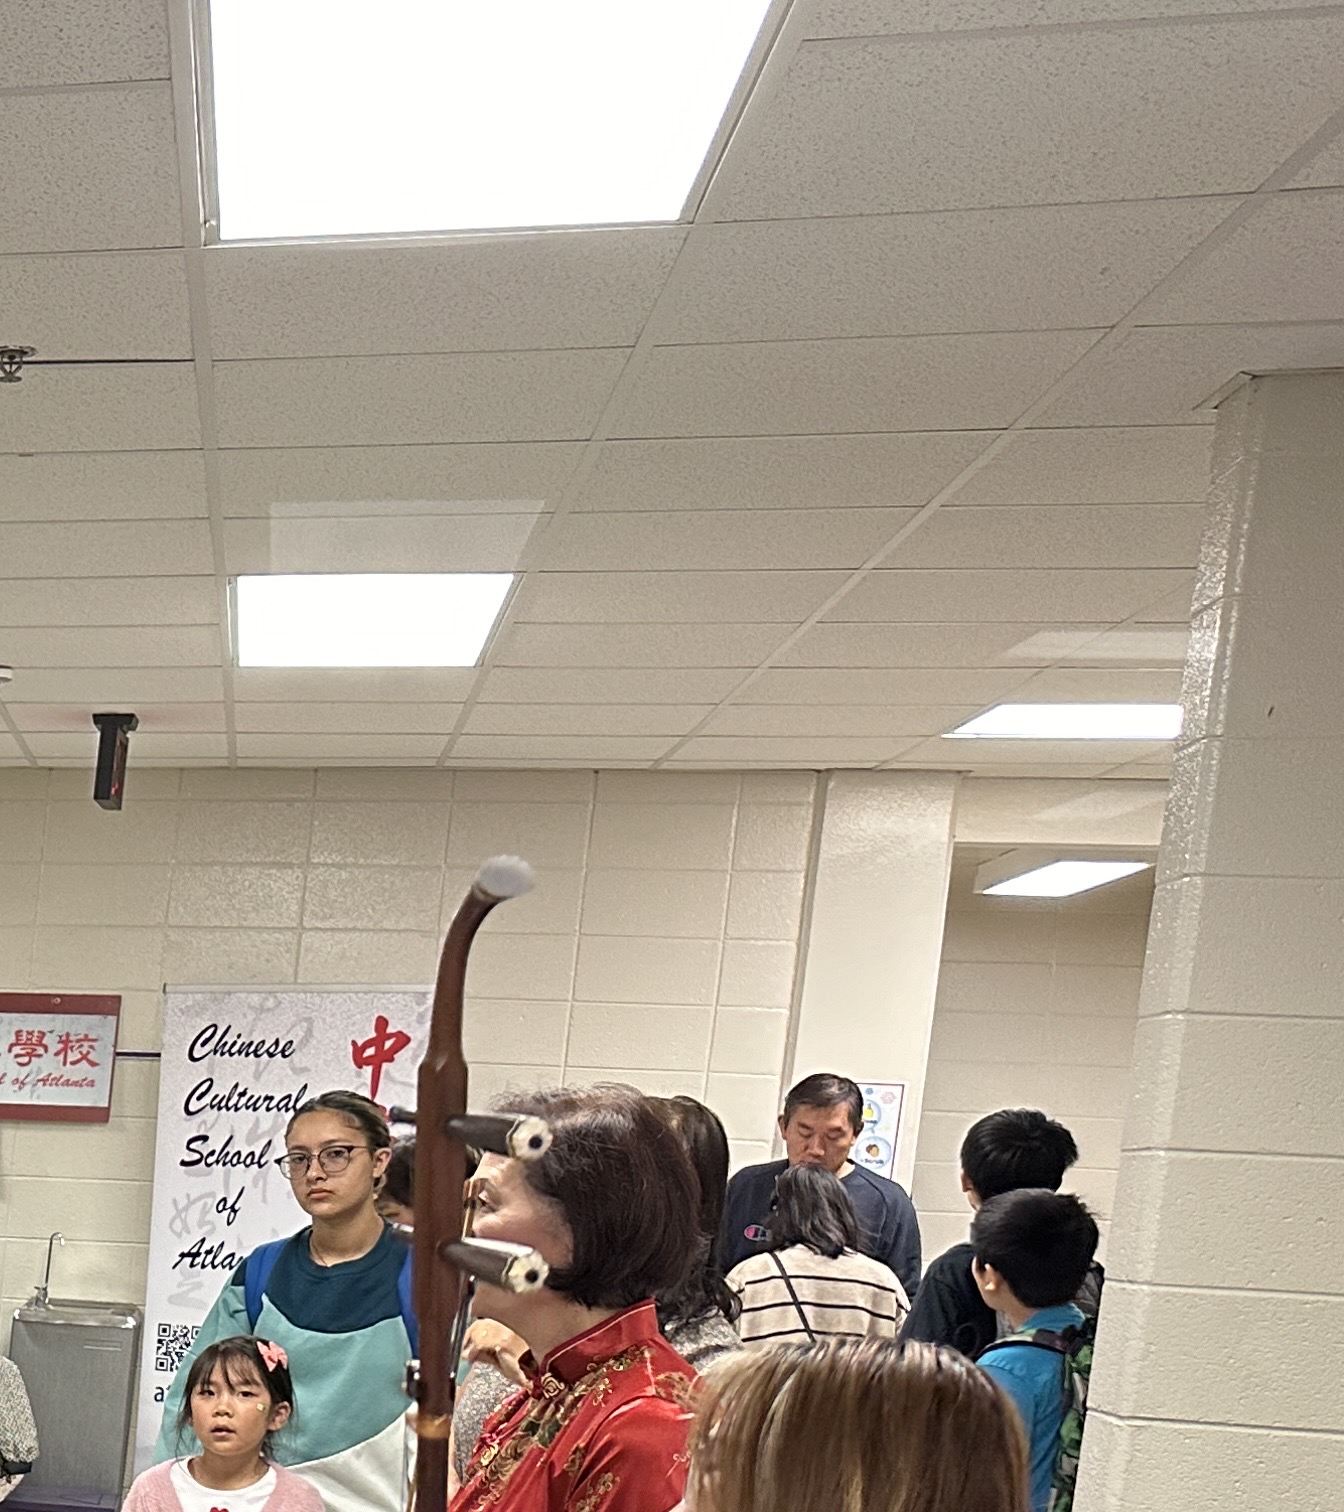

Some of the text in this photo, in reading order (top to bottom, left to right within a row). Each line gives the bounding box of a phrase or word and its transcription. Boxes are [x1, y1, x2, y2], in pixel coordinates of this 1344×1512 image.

[187, 1024, 295, 1063] Chinese
[12, 1073, 30, 1089] of
[30, 1074, 96, 1088] Atlanta
[183, 1077, 308, 1117] Cultural
[180, 1134, 273, 1169] School
[215, 1186, 246, 1226] of
[172, 1236, 245, 1271] Atla
